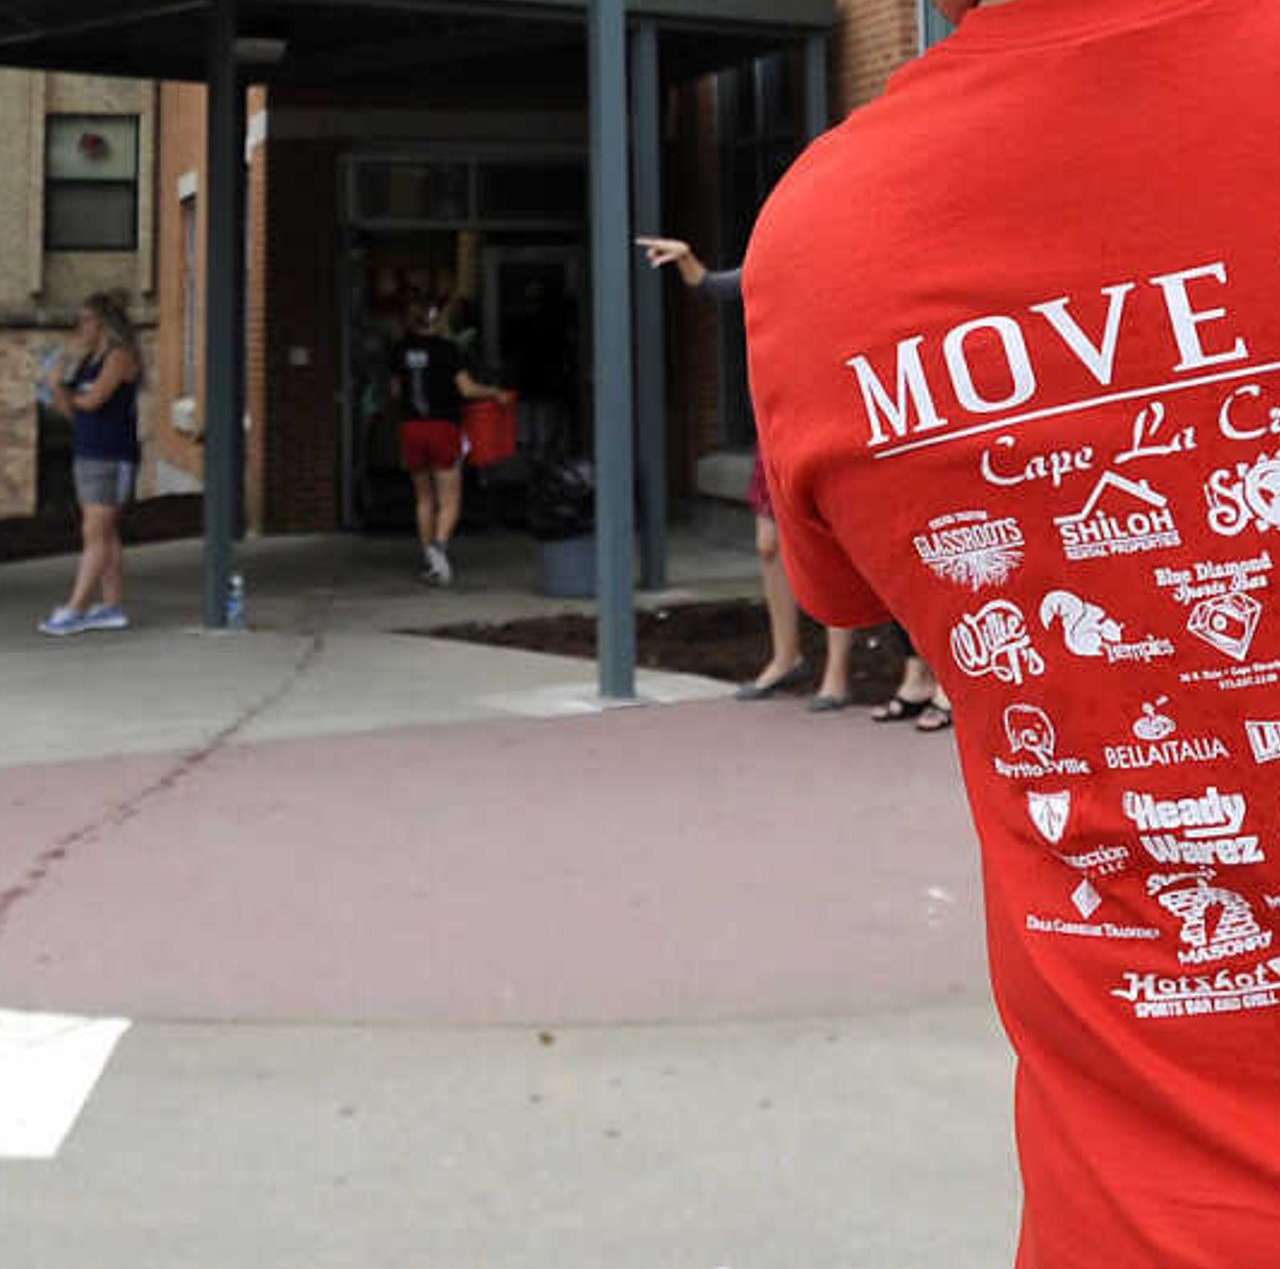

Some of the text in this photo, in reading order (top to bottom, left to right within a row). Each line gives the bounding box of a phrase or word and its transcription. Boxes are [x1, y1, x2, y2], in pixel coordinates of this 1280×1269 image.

[844, 261, 1249, 448] MOVE
[981, 435, 1094, 489] Cape
[1115, 401, 1198, 464] La
[1123, 786, 1247, 838] Heady
[1138, 833, 1265, 866] Warez
